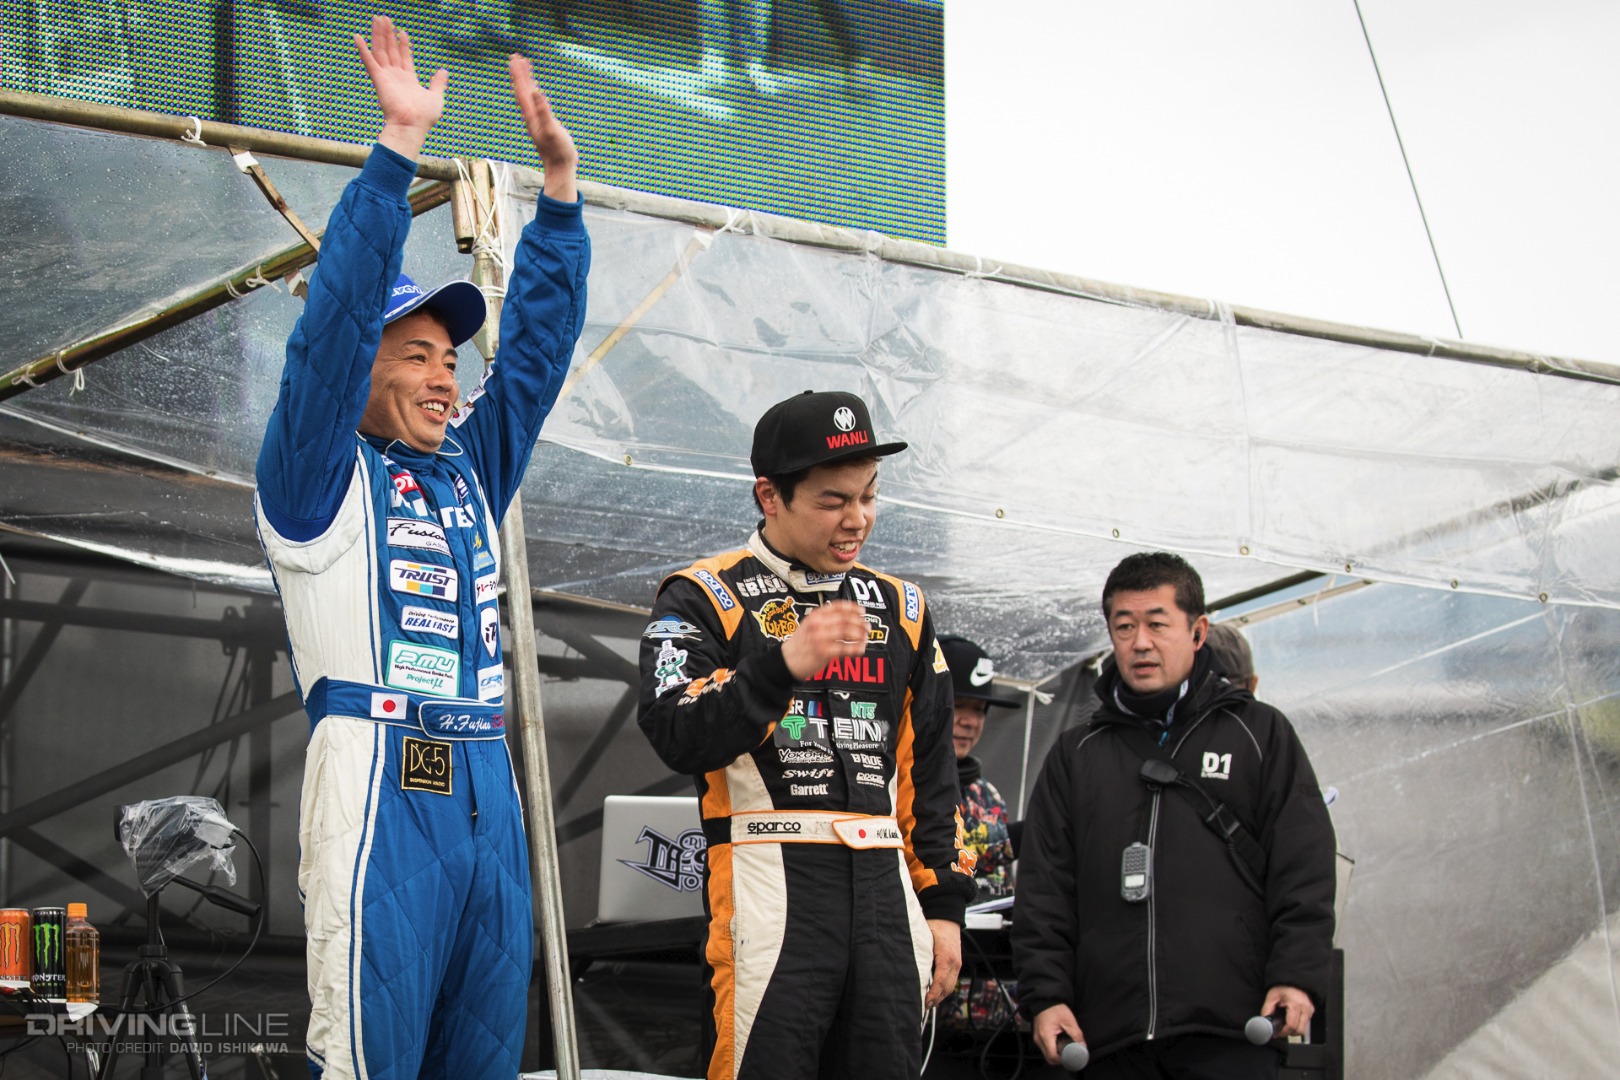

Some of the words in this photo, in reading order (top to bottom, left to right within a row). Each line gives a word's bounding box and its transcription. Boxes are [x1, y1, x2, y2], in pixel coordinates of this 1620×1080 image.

[826, 430, 869, 449] WANLI
[394, 567, 456, 586] TRUST
[694, 570, 735, 609] sparco
[849, 576, 884, 603] D1
[405, 617, 431, 628] REAL
[432, 621, 456, 633] FAST
[850, 701, 877, 719] NTS
[808, 717, 881, 741] TEIN
[850, 753, 883, 766] BRIDE
[1203, 751, 1232, 774] D1
[790, 784, 829, 796] Garrett
[747, 820, 802, 835] sparco
